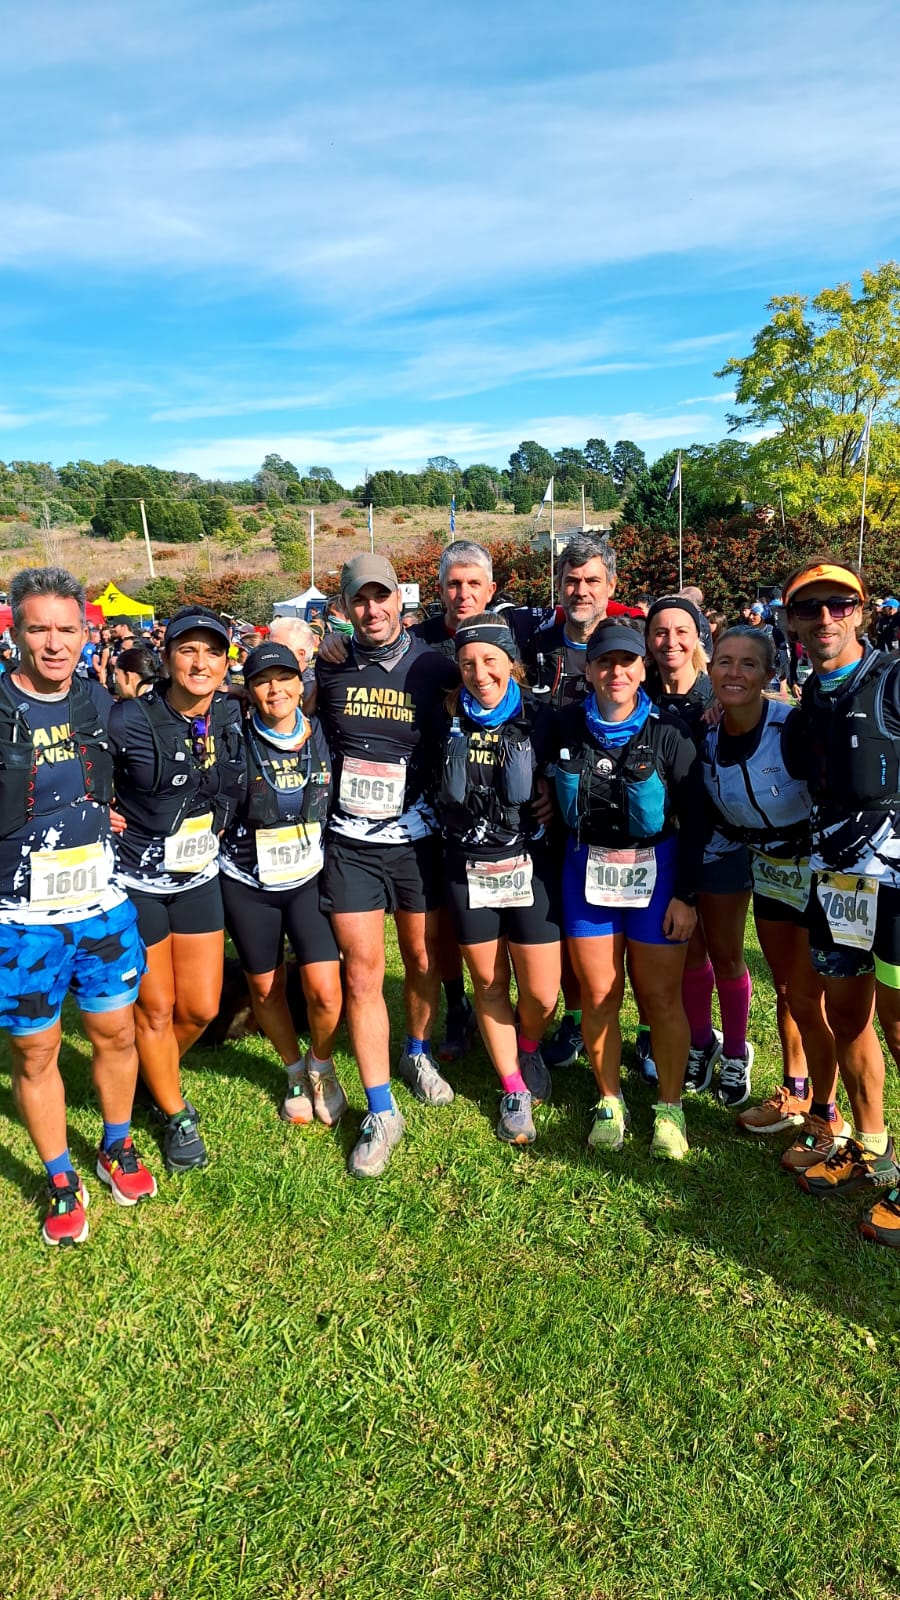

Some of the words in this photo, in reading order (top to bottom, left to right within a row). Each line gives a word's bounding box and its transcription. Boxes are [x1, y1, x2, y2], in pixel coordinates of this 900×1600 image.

[346, 687, 416, 708] TANDIL
[343, 702, 416, 723] ADVENTURE
[349, 777, 395, 802] 1061
[43, 865, 97, 896] 1601
[594, 865, 648, 888] 1082
[821, 891, 868, 926] 1684
